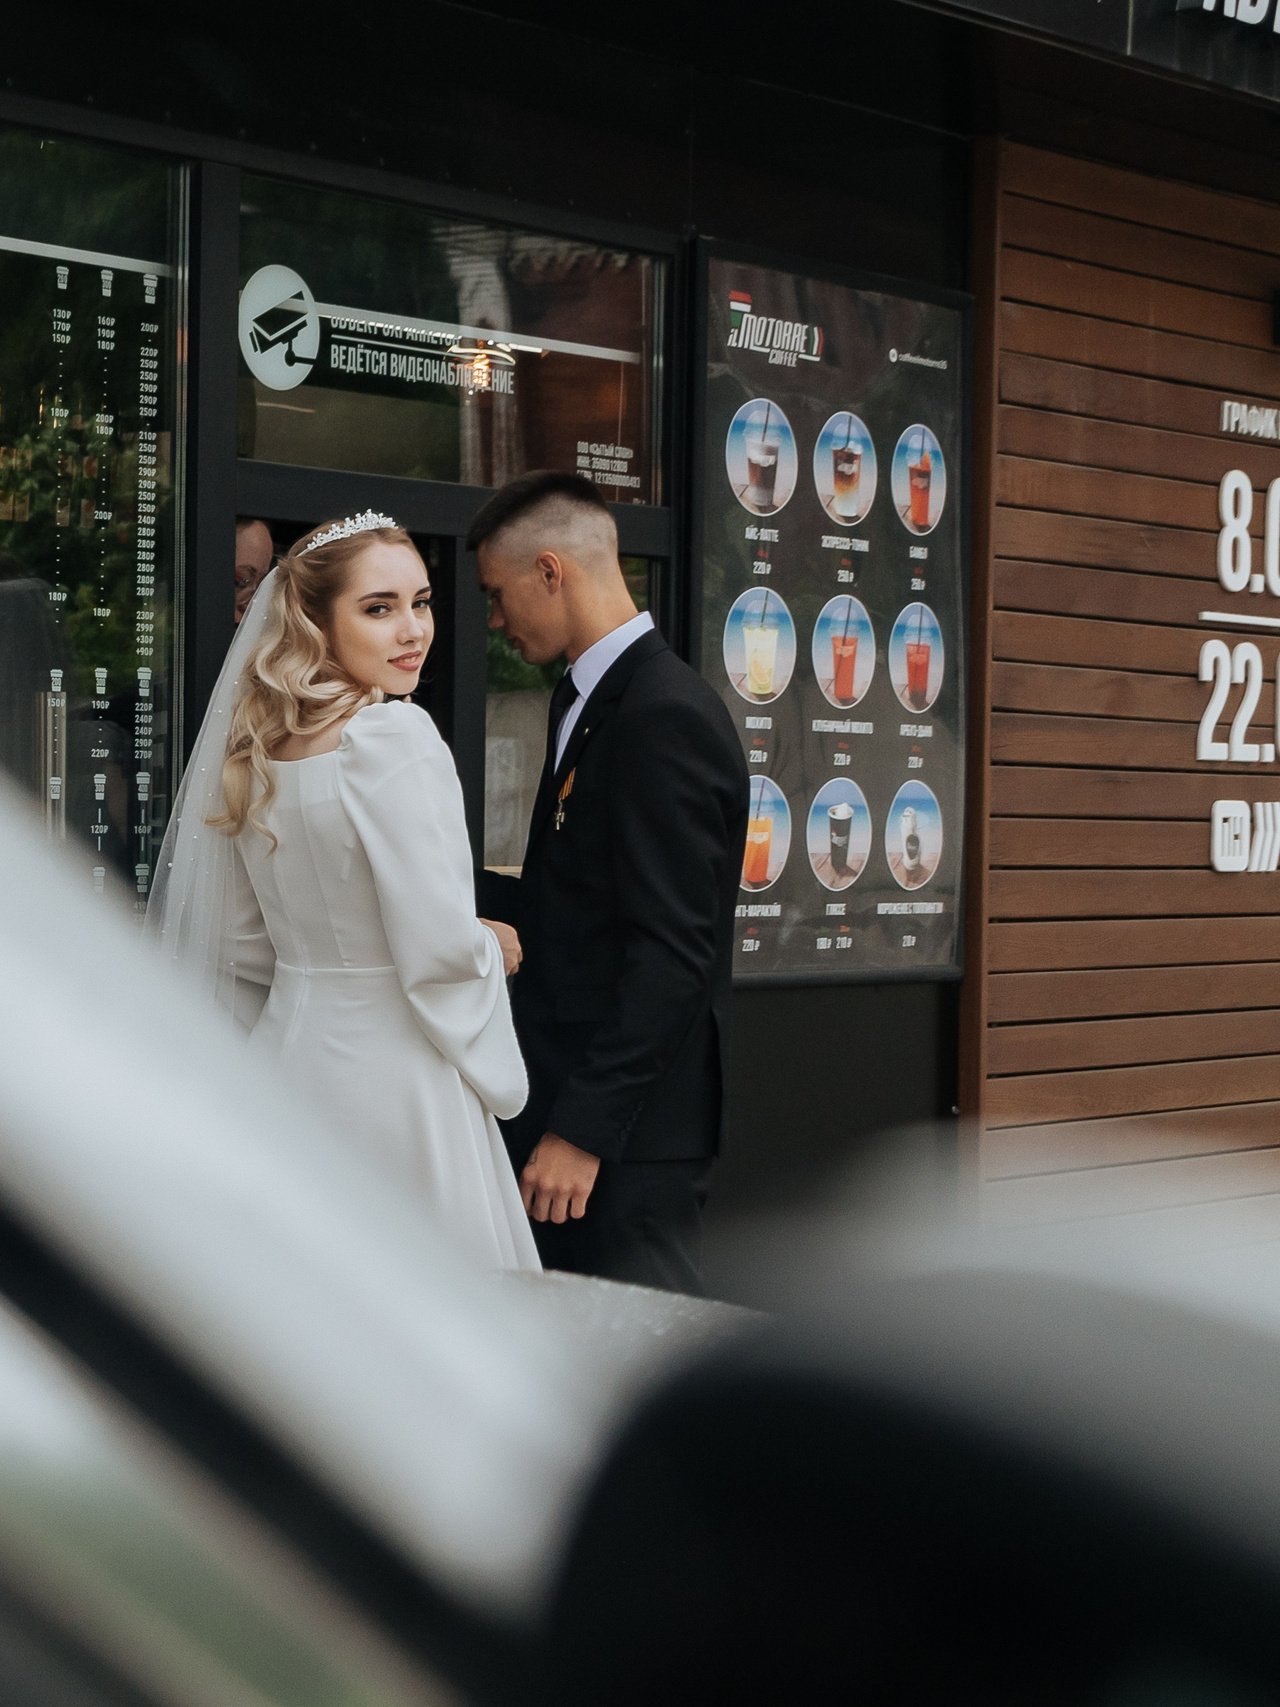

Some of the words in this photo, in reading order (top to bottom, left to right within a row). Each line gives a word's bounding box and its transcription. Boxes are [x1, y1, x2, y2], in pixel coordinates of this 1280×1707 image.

[145, 286, 156, 296] 400
[53, 308, 71, 319] 130₽
[98, 316, 115, 326] 160₽
[140, 322, 158, 333] 200₽
[52, 321, 71, 332] 170₽
[98, 328, 115, 338] 190₽
[738, 314, 808, 353] MOTORRE
[52, 334, 71, 344] 150₽
[97, 340, 114, 350] 180₽
[140, 347, 158, 357] 220₽
[140, 359, 158, 369] 250₽
[330, 343, 387, 375] ВЕДЁТСЯ
[768, 350, 799, 368] COFFEE
[140, 371, 158, 381] 250₽
[140, 382, 157, 393] 290₽
[140, 394, 158, 405] 290₽
[51, 408, 69, 418] 180₽
[96, 414, 114, 424] 200₽
[139, 407, 157, 417] 250₽
[1222, 400, 1278, 439] ГРАФИК
[96, 426, 114, 436] 180₽
[139, 431, 157, 440] 210₽
[139, 443, 156, 453] 250₽
[138, 455, 156, 465] 250₽
[138, 467, 156, 477] 290₽
[138, 479, 156, 489] 290₽
[138, 491, 156, 501] 250₽
[138, 503, 156, 513] 250₽
[94, 510, 112, 520] 200₽
[138, 515, 156, 525] 240₽
[138, 528, 156, 537] 280₽
[137, 539, 155, 548] 280₽
[137, 551, 155, 560] 280₽
[137, 563, 155, 573] 280₽
[136, 574, 154, 584] 280₽
[136, 586, 154, 596] 280₽
[48, 592, 67, 602] 180₽
[93, 608, 111, 617] 180₽
[136, 610, 154, 620] 230₽
[52, 678, 62, 686] 200
[139, 680, 150, 688] 400
[1196, 638, 1280, 763] 22.
[92, 700, 110, 710] 190₽
[135, 702, 152, 712] 220₽
[135, 714, 152, 724] 240₽
[134, 726, 152, 736] 240₽
[134, 738, 152, 748] 290₽
[92, 749, 109, 758] 220₽
[134, 750, 152, 759] 270₽
[138, 784, 148, 793] 400
[90, 825, 108, 834] 120₽
